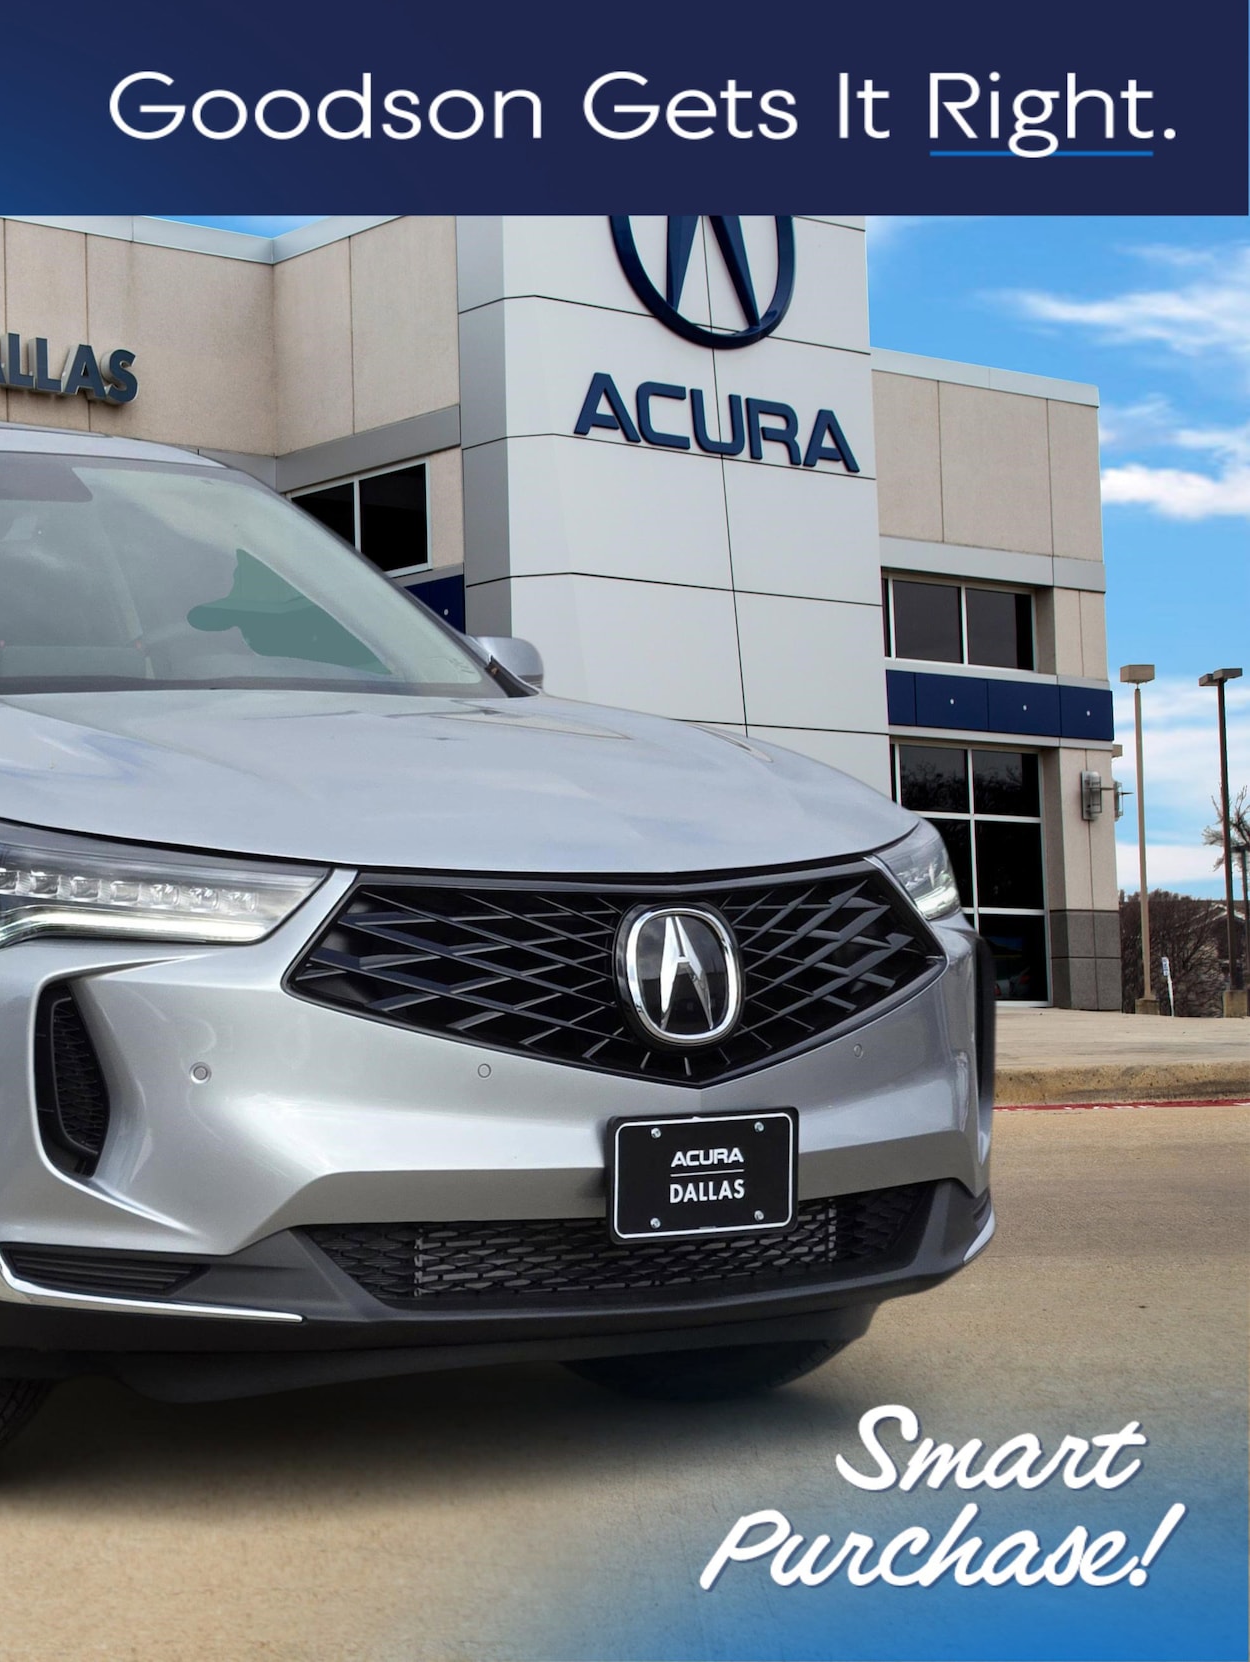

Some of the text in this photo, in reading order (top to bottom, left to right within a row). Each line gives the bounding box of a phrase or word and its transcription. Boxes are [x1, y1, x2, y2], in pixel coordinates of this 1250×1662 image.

[573, 372, 860, 474] ACURA
[670, 1147, 744, 1168] ACURA
[669, 1178, 745, 1204] DALLAS
